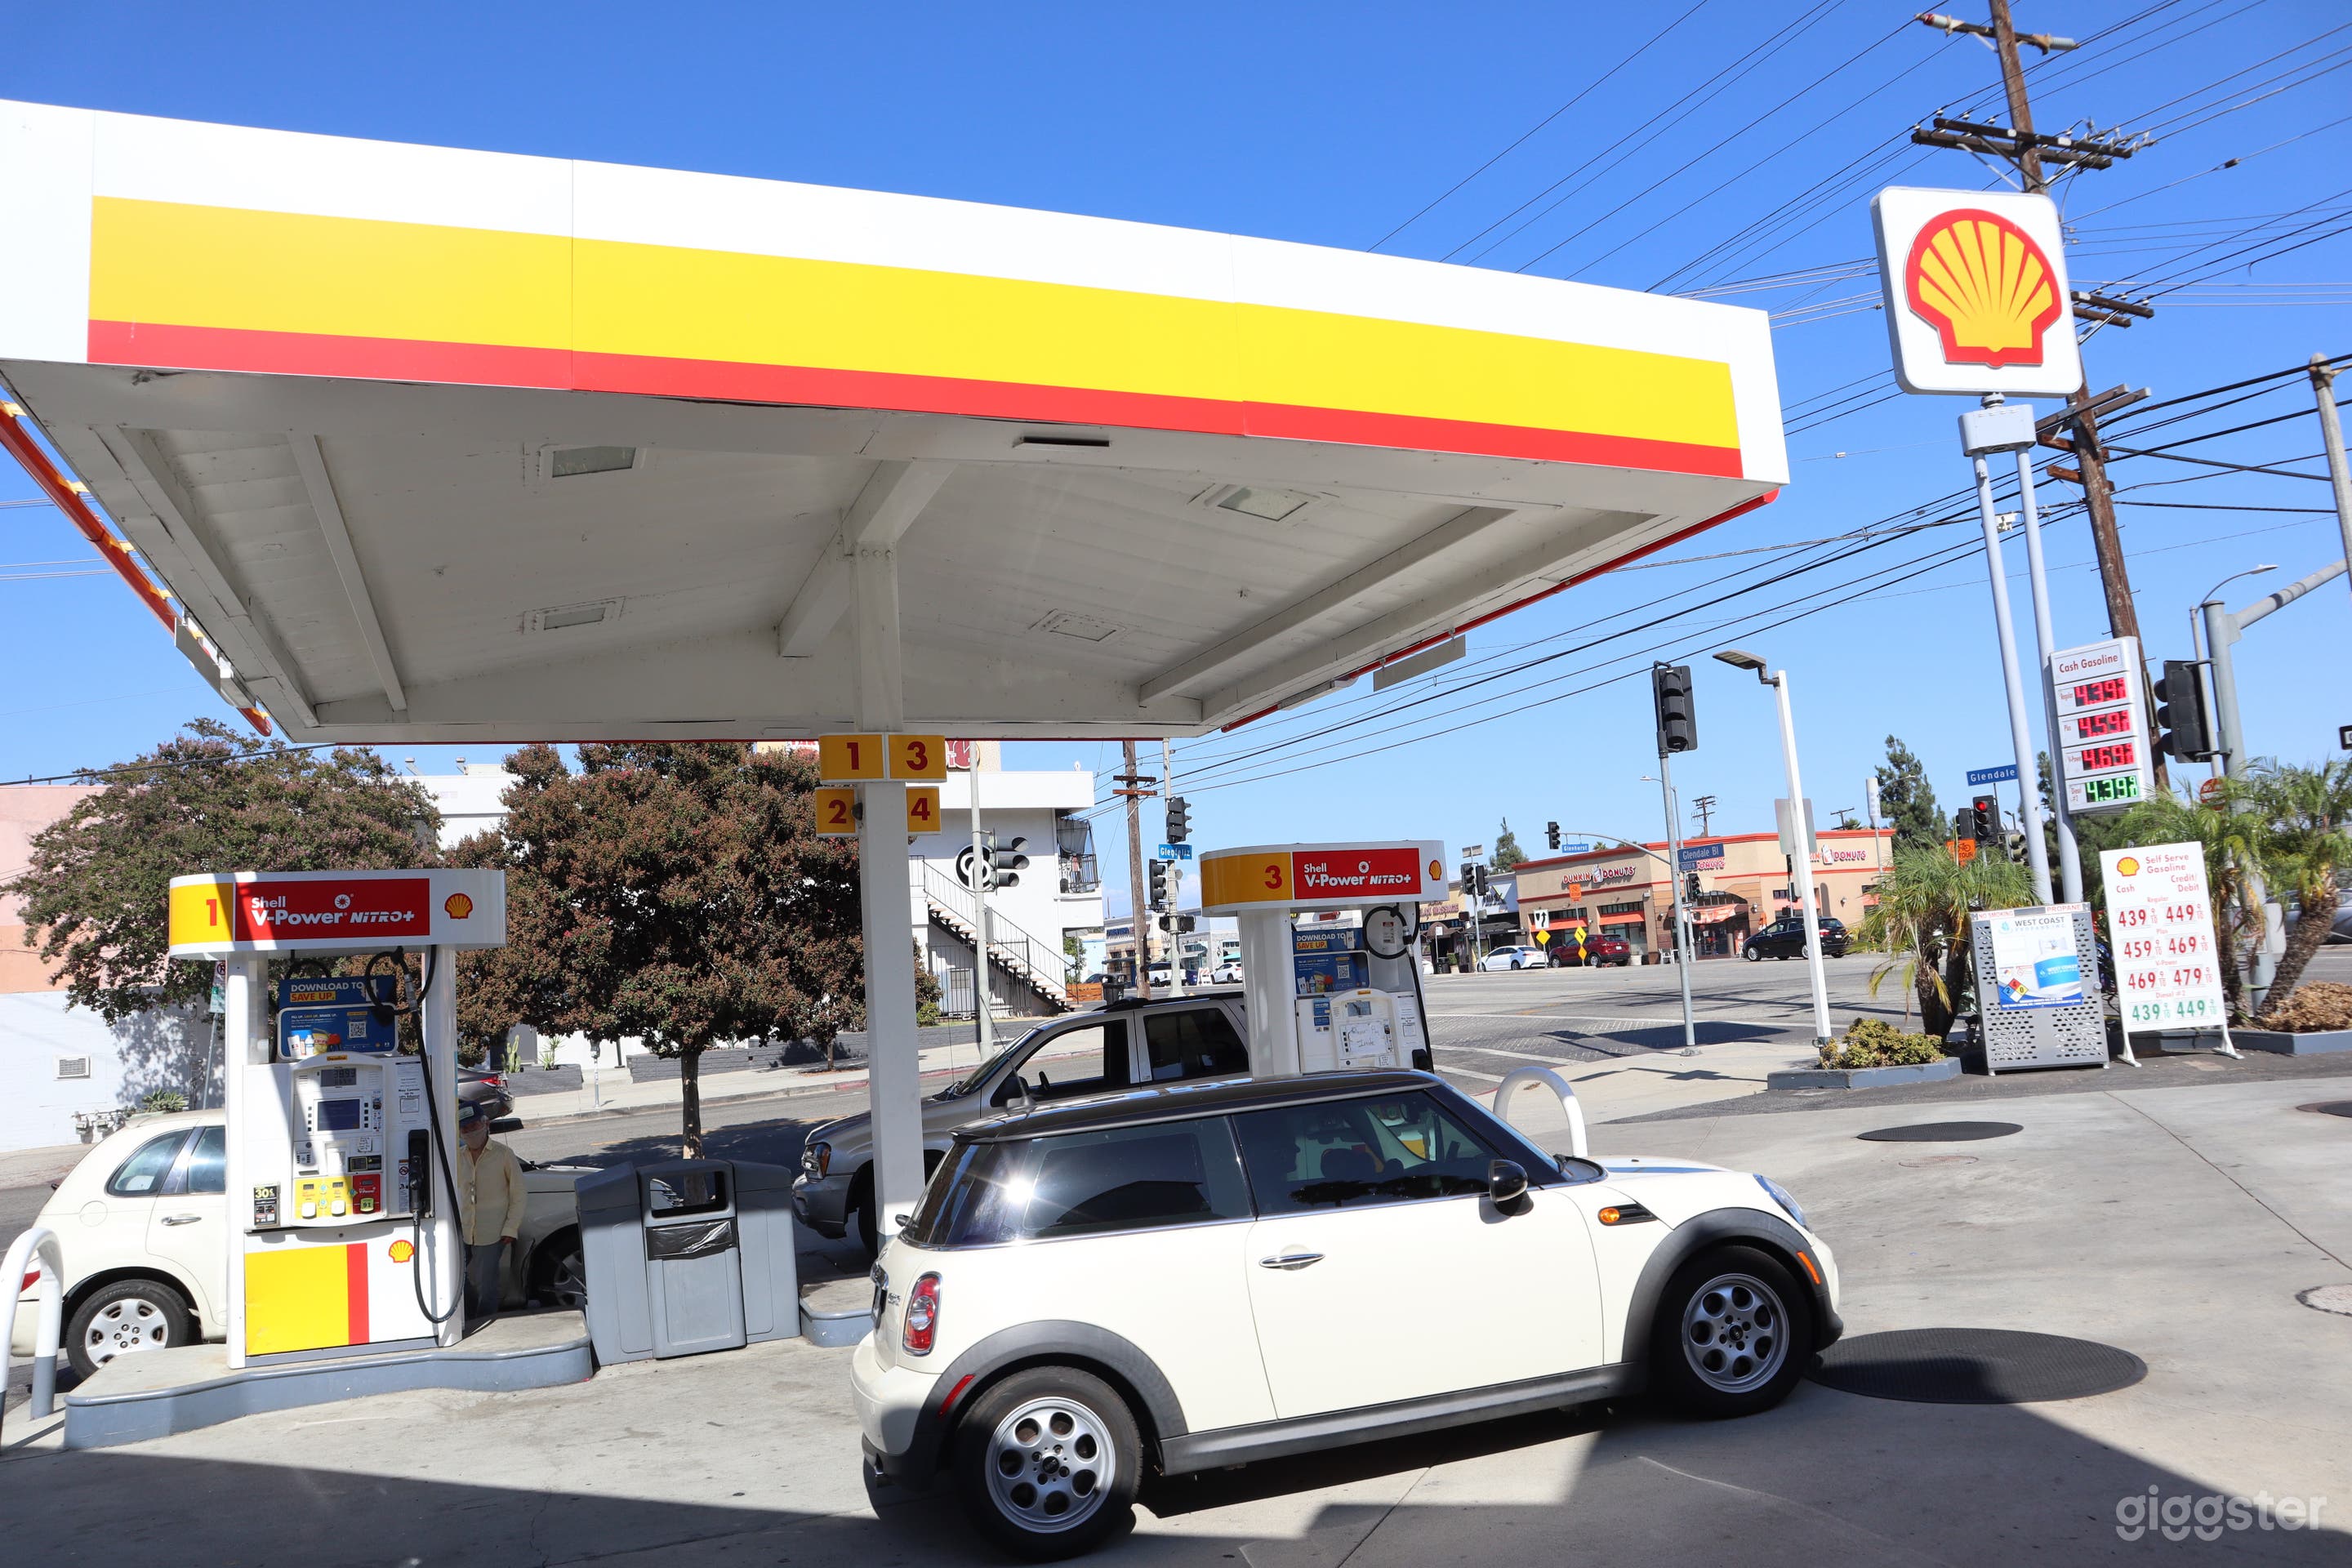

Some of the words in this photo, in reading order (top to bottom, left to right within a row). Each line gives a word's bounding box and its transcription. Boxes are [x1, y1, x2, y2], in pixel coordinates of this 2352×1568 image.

[2059, 661, 2079, 673] Cash
[2081, 655, 2118, 669] Gasoline
[847, 742, 860, 770] 1
[906, 742, 928, 771] 3
[1971, 769, 2016, 782] Glendale
[828, 800, 847, 824] 2
[911, 797, 930, 821] 4
[1682, 849, 1710, 861] Glendale
[1712, 846, 1719, 855] Bl
[1834, 851, 1867, 860] DONUTS
[2145, 855, 2162, 864] Self
[2164, 854, 2189, 862] Serve
[1304, 862, 1327, 873] Shell
[1603, 866, 1635, 879] DONUTS
[2146, 864, 2186, 874] Gasoline
[1264, 866, 1282, 889] 3
[1304, 874, 1365, 887] V-Power
[2116, 884, 2136, 893] Cash
[2177, 884, 2199, 893] Debit
[252, 896, 286, 908] Shell
[206, 898, 218, 926] 1
[252, 910, 344, 926] V-Power
[2118, 909, 2147, 927] 439
[2166, 904, 2194, 922] 449
[2015, 919, 2037, 927] WEST
[2038, 916, 2065, 924] COAST
[1297, 933, 1336, 942] DOWNLOAD
[2124, 941, 2152, 958] 459
[2169, 936, 2197, 954] 469
[2128, 972, 2156, 989] 469
[2174, 968, 2202, 986] 479
[291, 982, 350, 992] DOWNLOAD
[291, 992, 316, 1001] SAVE
[2132, 1004, 2161, 1022] 439
[2176, 1000, 2206, 1018] 449
